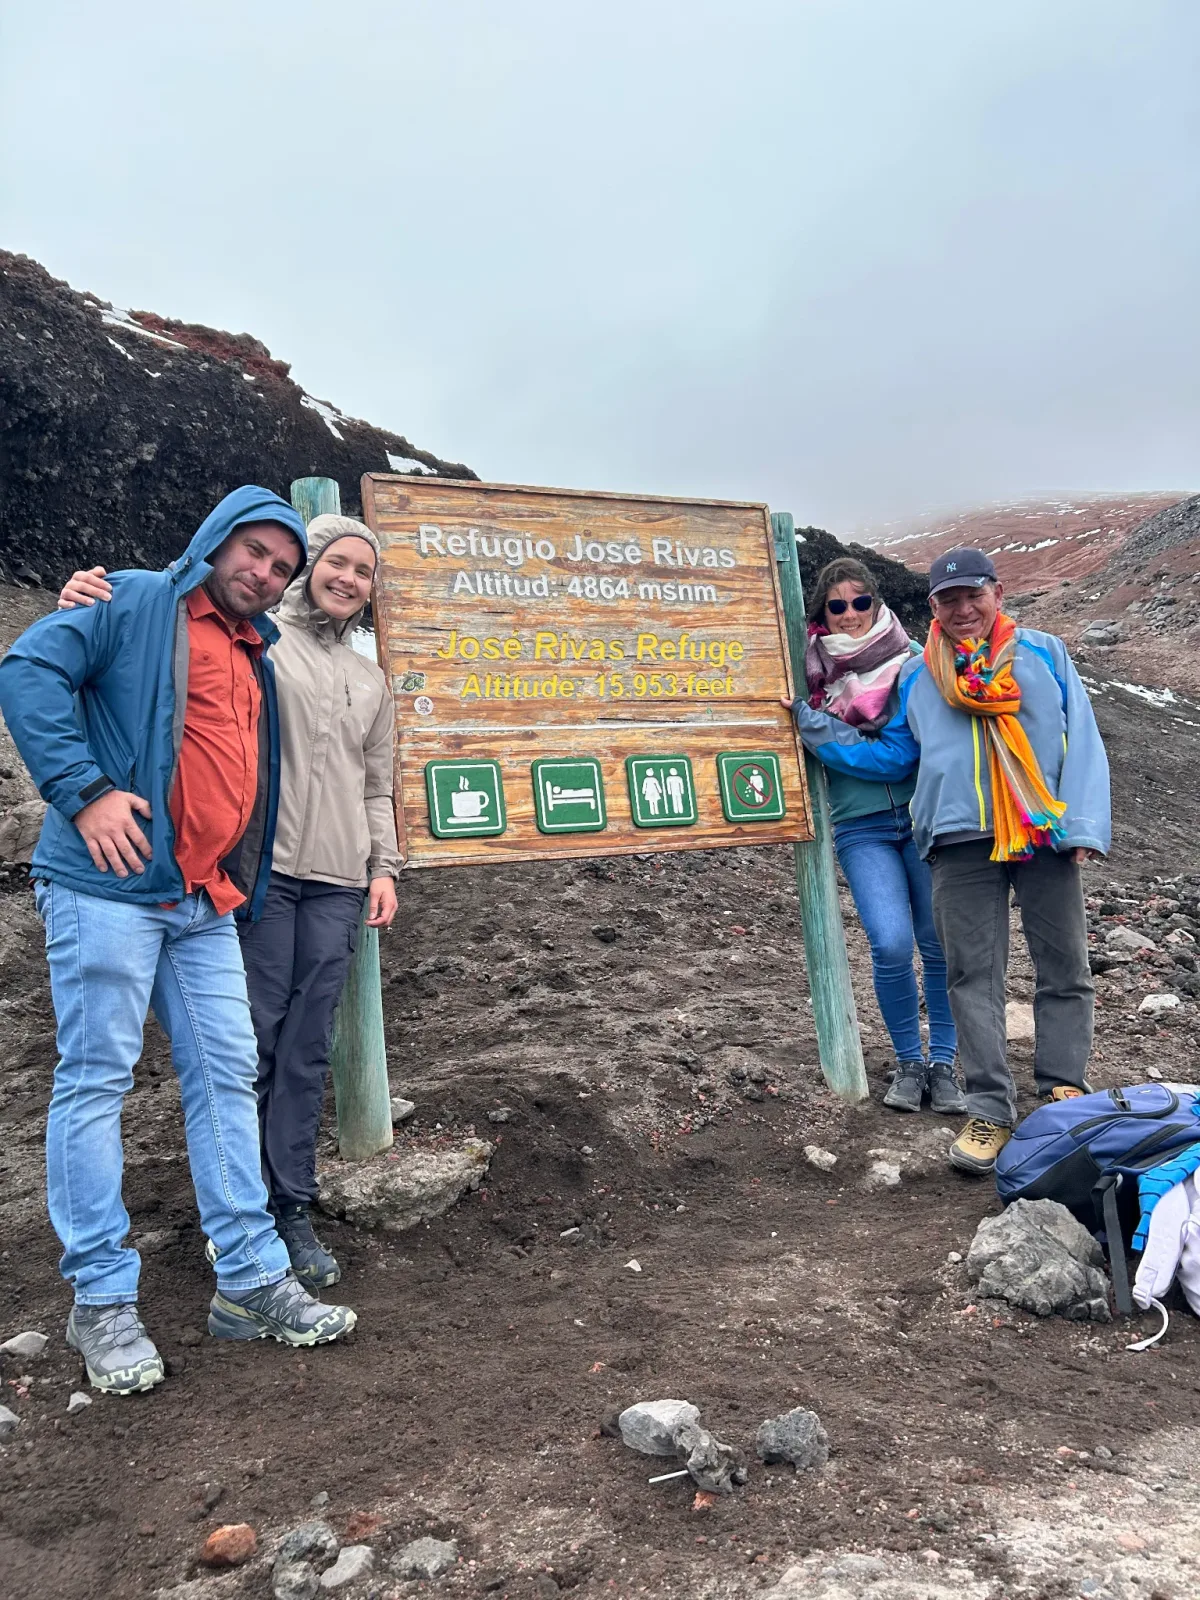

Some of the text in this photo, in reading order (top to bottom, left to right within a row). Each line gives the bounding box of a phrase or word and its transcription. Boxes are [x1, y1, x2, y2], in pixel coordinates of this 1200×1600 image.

[419, 524, 736, 568] Refugio José Rivas
[453, 570, 717, 601] Altitud: 4864 msnm
[437, 629, 744, 667] José Rivas Refuge
[461, 672, 734, 698] Altitude: 15.953 feet
